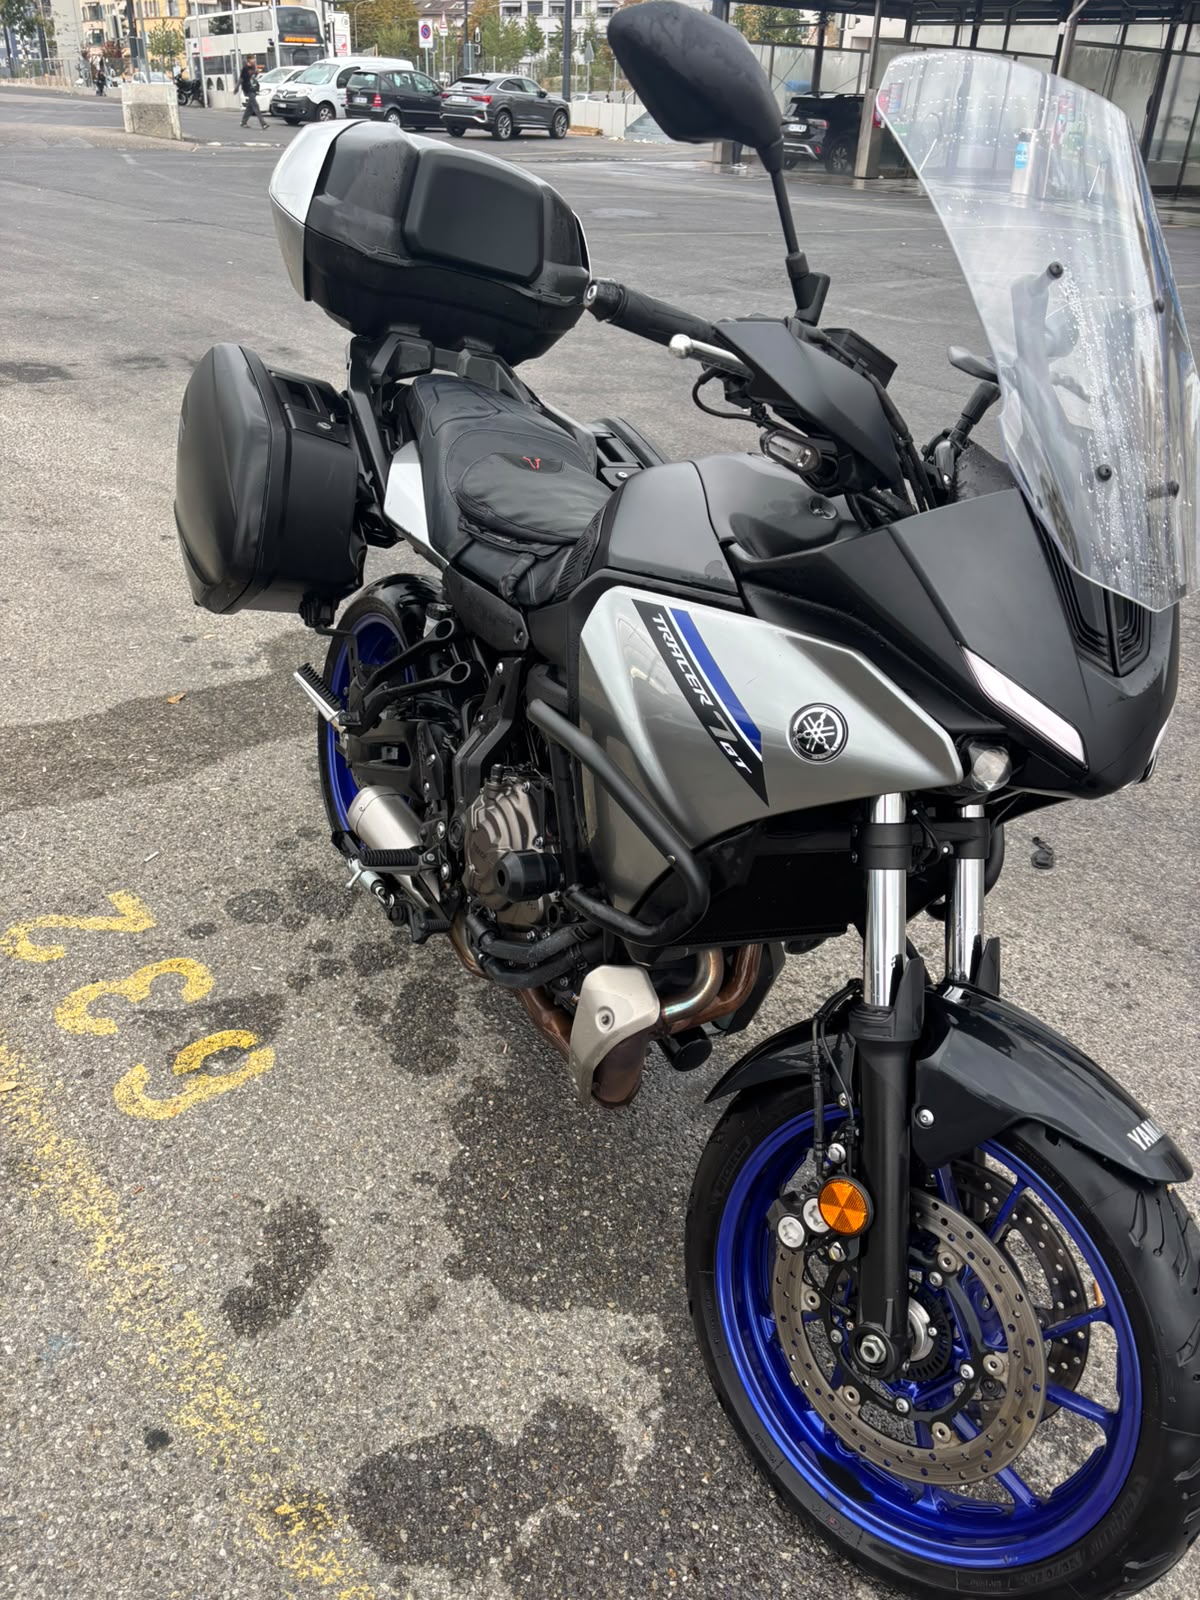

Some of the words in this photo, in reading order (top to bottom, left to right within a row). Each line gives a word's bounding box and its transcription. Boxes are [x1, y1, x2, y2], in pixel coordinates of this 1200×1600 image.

[652, 613, 714, 706] TRACER
[708, 711, 739, 743] 7
[720, 741, 752, 774] GT
